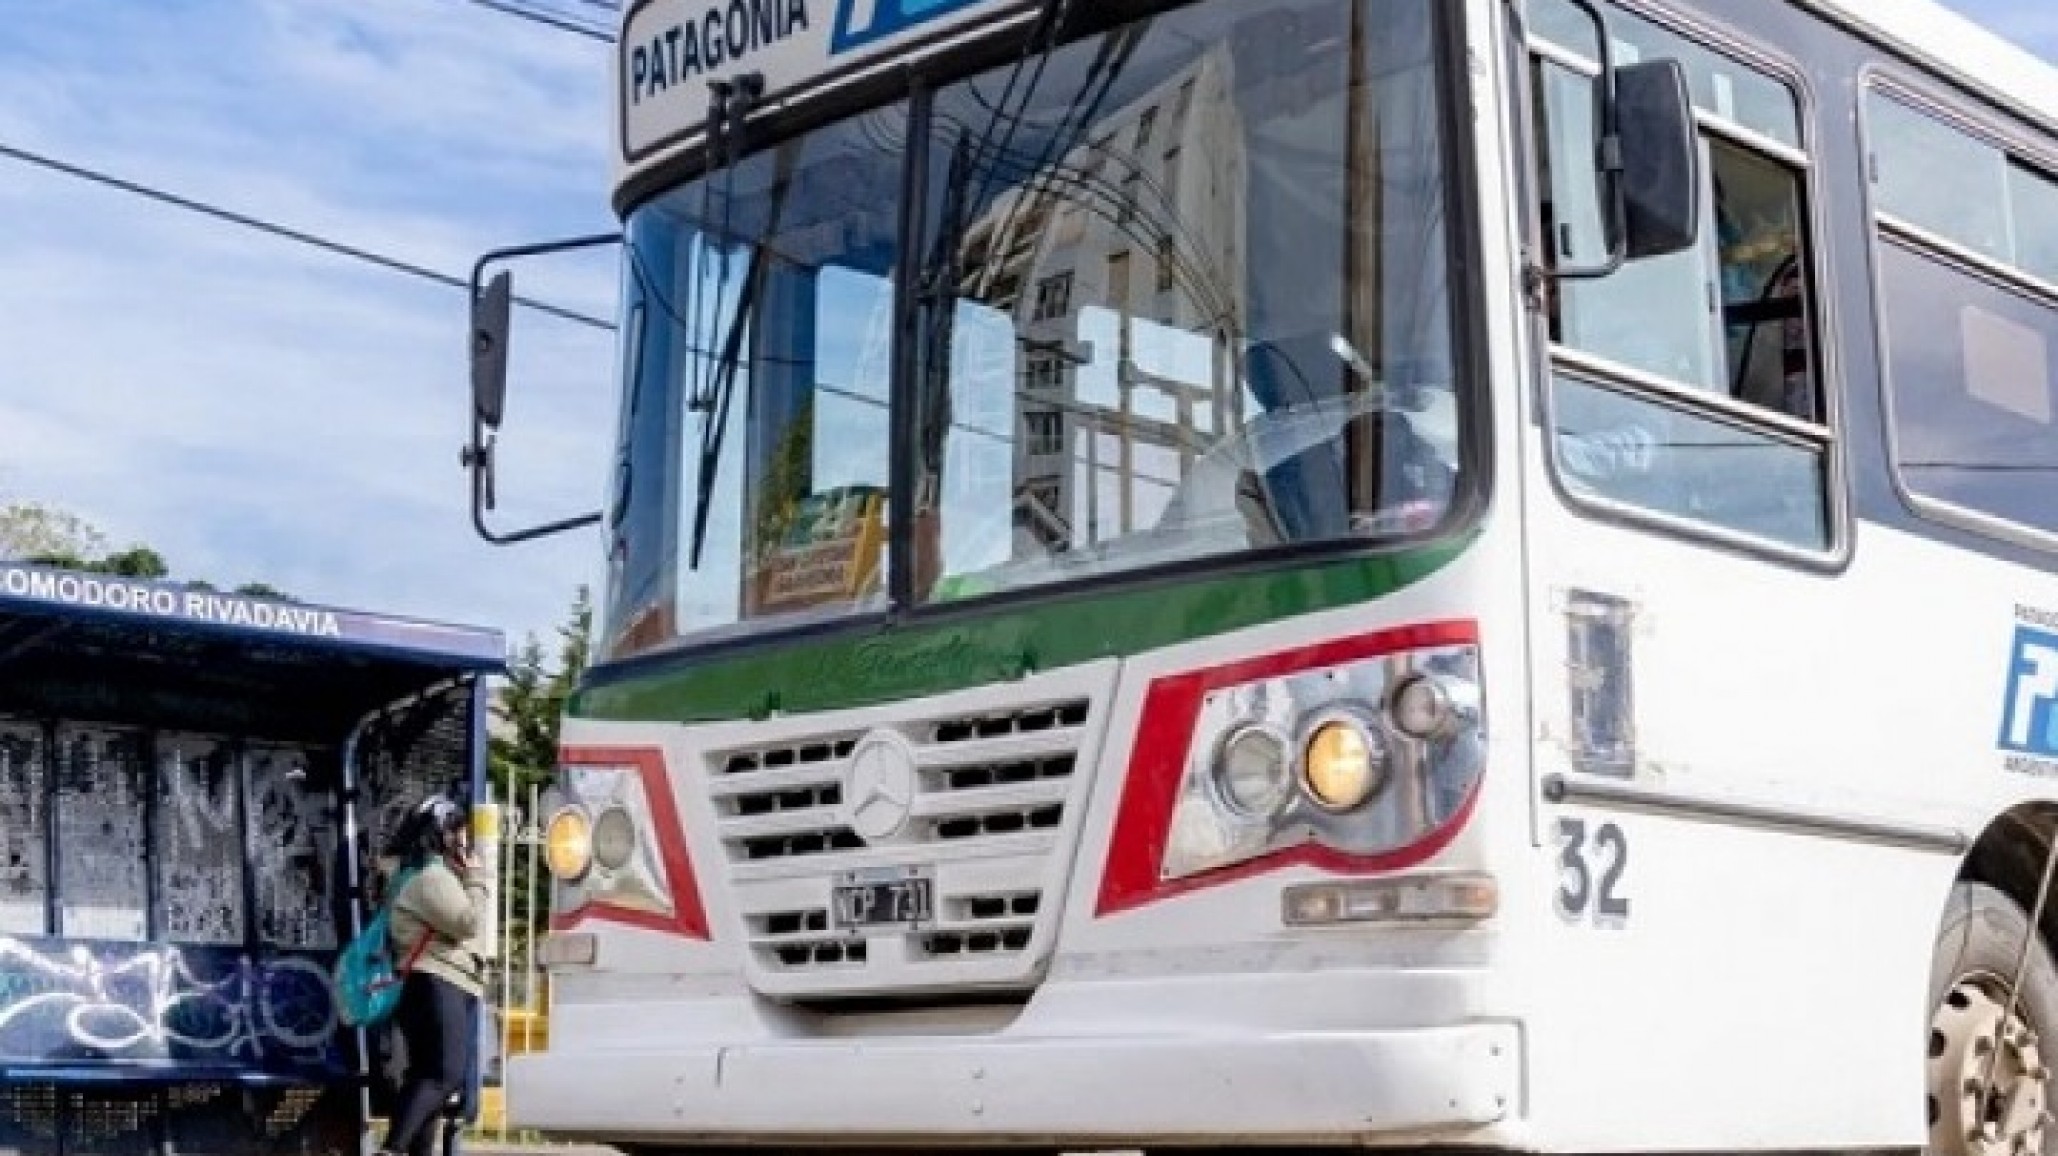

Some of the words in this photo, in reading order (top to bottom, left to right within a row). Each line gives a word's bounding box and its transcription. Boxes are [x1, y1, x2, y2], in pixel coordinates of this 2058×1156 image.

[632, 0, 809, 104] PATAGONIA
[1, 568, 173, 615] OMODORO
[185, 592, 340, 635] RIVADAVIA
[1556, 817, 1629, 919] 32
